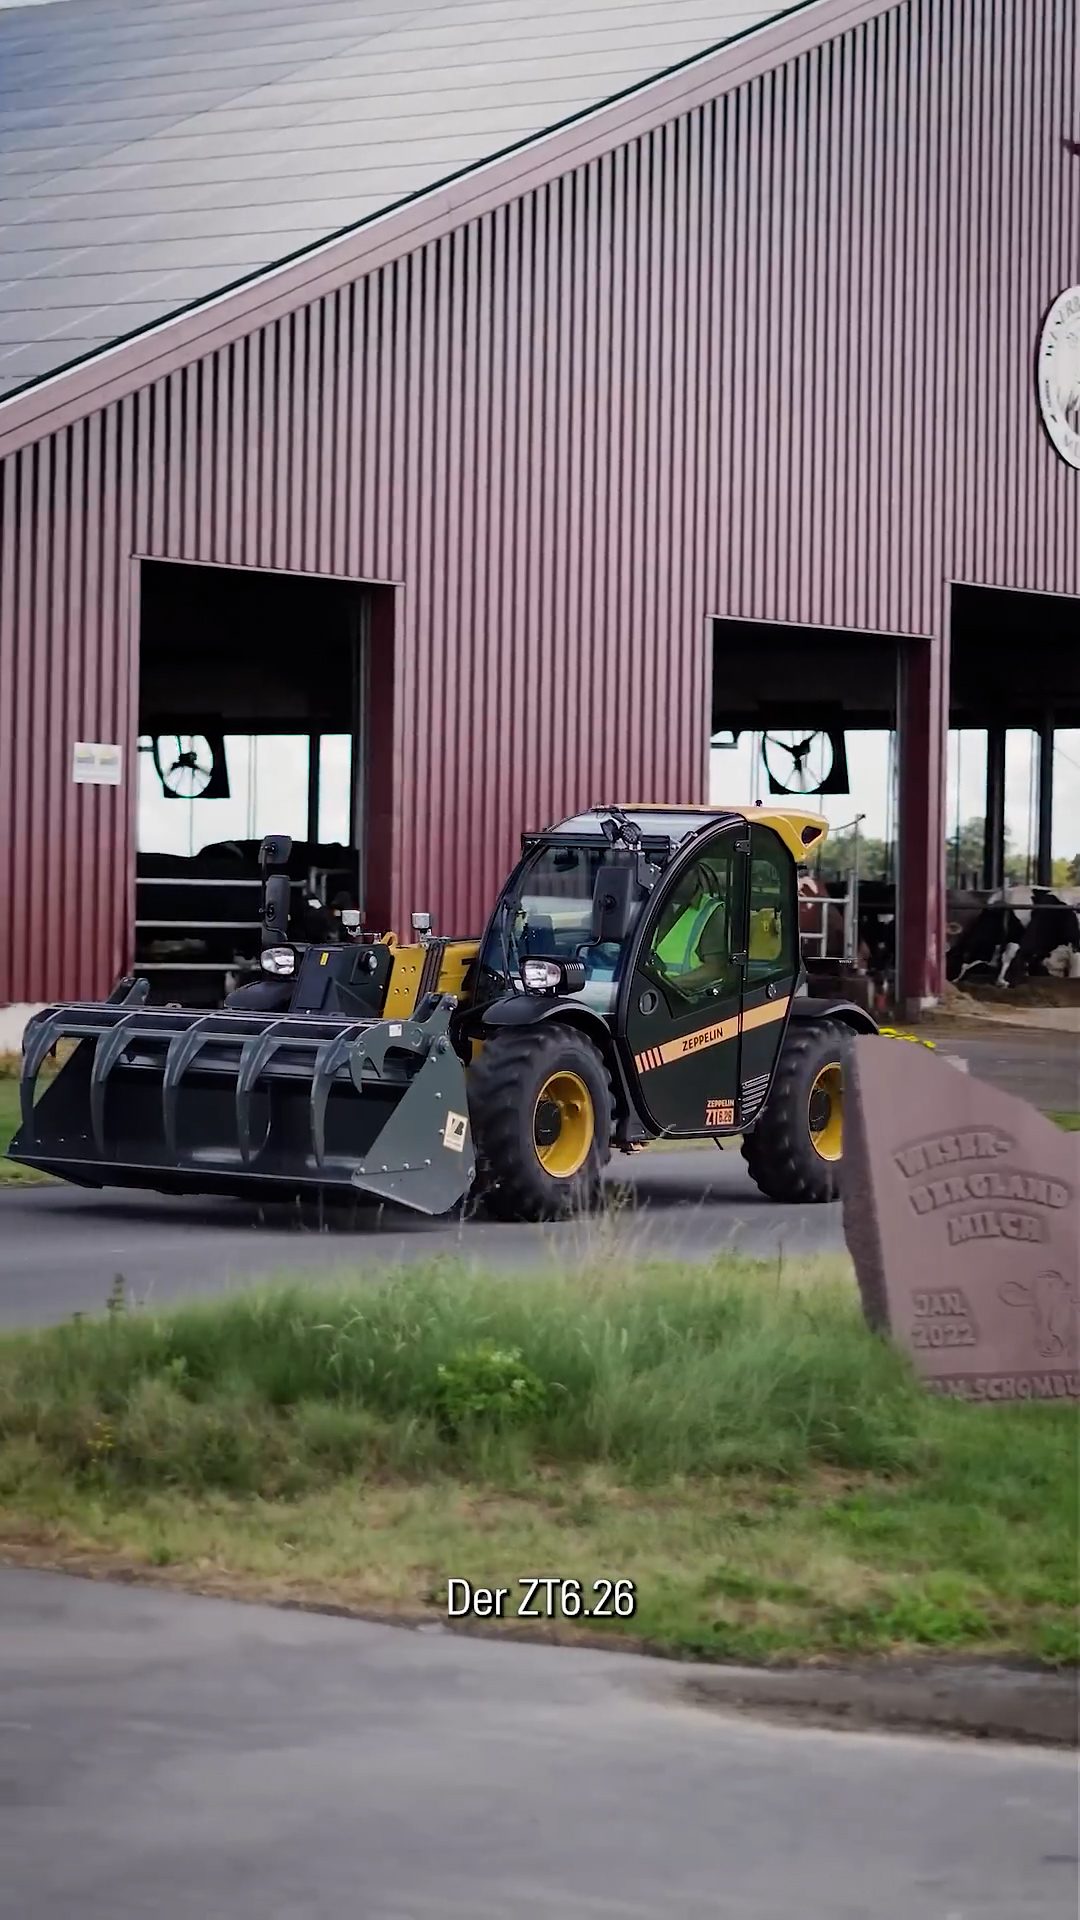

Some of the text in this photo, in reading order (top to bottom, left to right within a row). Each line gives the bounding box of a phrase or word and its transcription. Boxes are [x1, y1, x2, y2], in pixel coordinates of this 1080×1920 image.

[682, 1027, 723, 1051] ZEPPELIN
[706, 1099, 735, 1108] ZEPPELIN
[909, 1172, 1069, 1215] BERGLAND
[947, 1211, 1043, 1246] MILCH
[911, 1324, 977, 1348] 2022
